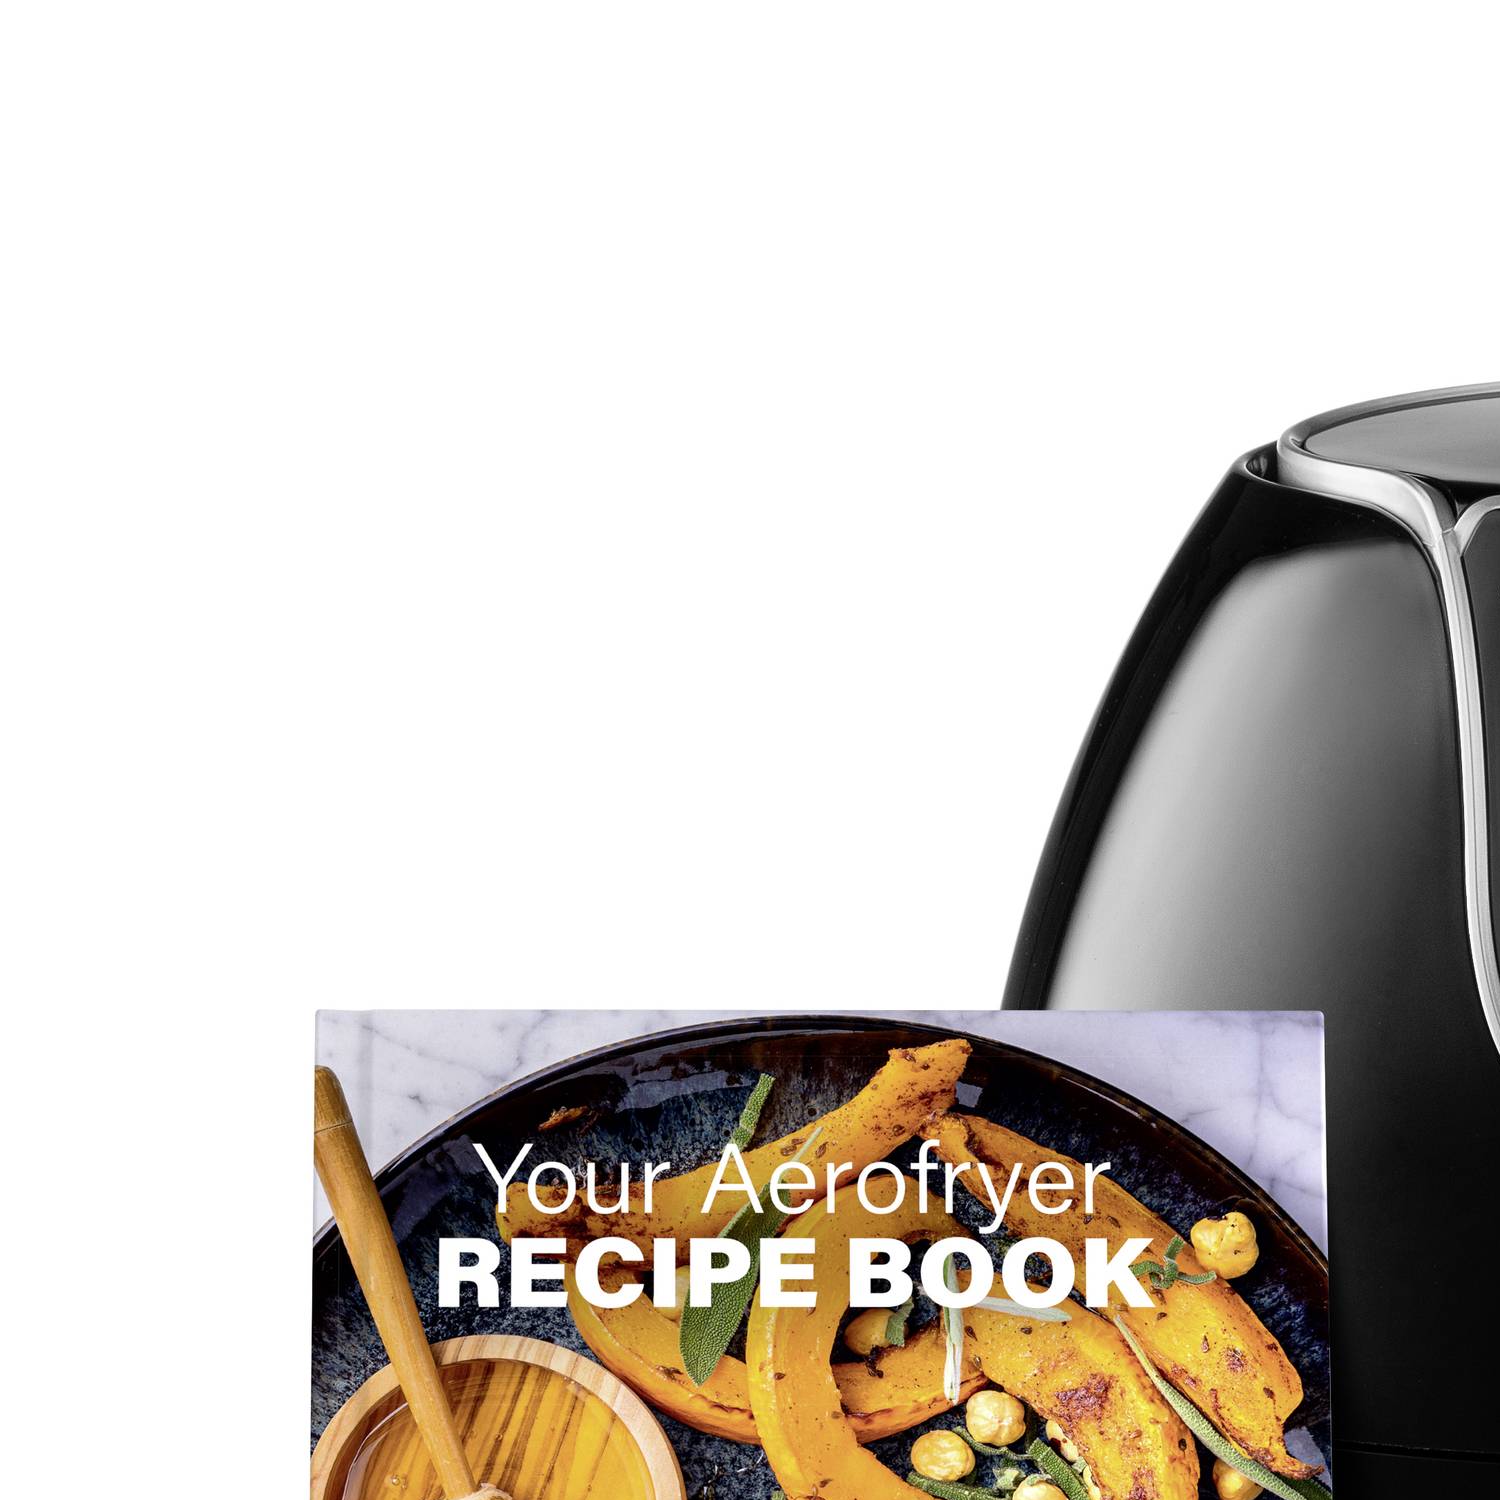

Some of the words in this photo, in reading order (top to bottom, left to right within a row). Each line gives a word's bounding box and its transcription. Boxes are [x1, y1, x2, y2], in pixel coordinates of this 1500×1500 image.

[472, 1143, 671, 1215] Your
[701, 1139, 1111, 1235] Aerofryer
[438, 1236, 818, 1309] RECIPE
[849, 1236, 1155, 1309] BOOK
